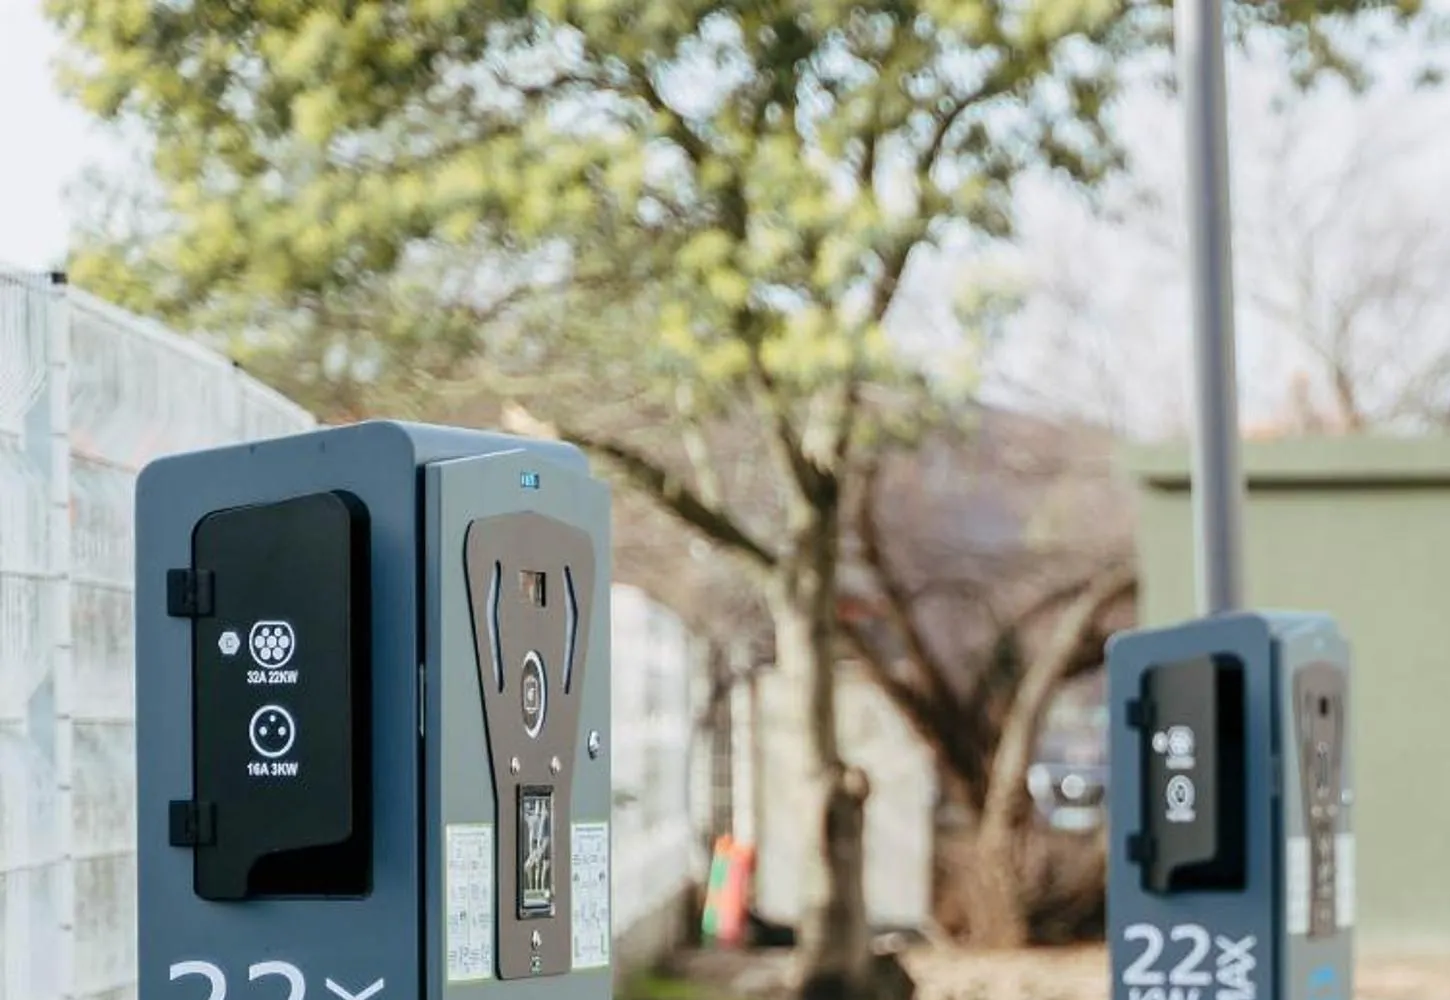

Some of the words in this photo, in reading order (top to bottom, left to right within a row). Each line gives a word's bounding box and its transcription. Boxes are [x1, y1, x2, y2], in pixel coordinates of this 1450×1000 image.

[247, 669, 268, 684] 32A
[268, 669, 299, 684] 22KW
[247, 761, 270, 776] 16A
[270, 761, 299, 776] 3KW
[1122, 923, 1213, 986] 22
